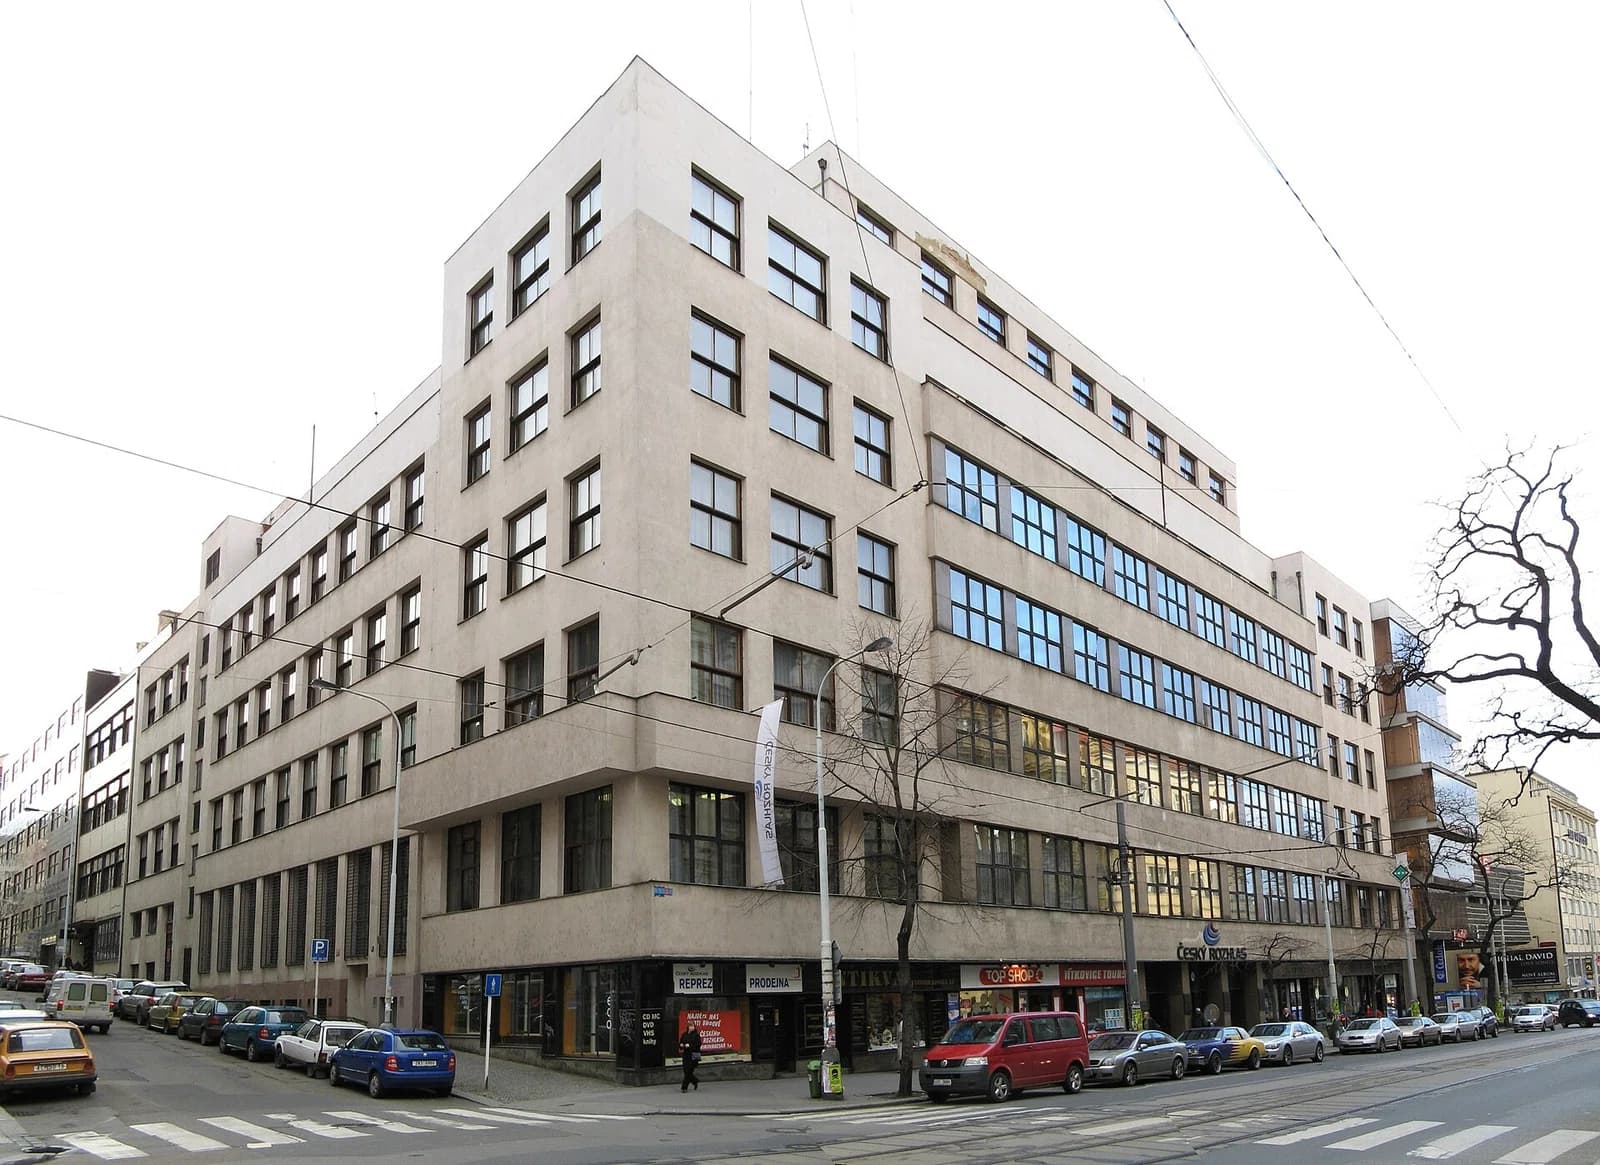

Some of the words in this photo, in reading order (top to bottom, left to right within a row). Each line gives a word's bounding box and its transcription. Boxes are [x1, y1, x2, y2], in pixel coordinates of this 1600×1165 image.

[315, 941, 325, 953] P
[1177, 942, 1207, 960] ČESKÝ
[1208, 947, 1248, 960] ROZHLAS
[1525, 952, 1554, 960] DAVID
[986, 970, 1007, 983] TOP
[1008, 969, 1035, 983] SHOP
[679, 978, 713, 989] REPREZ
[750, 978, 790, 988] PRODEJNA
[642, 1021, 655, 1029] DVD
[642, 1029, 655, 1037] VHS
